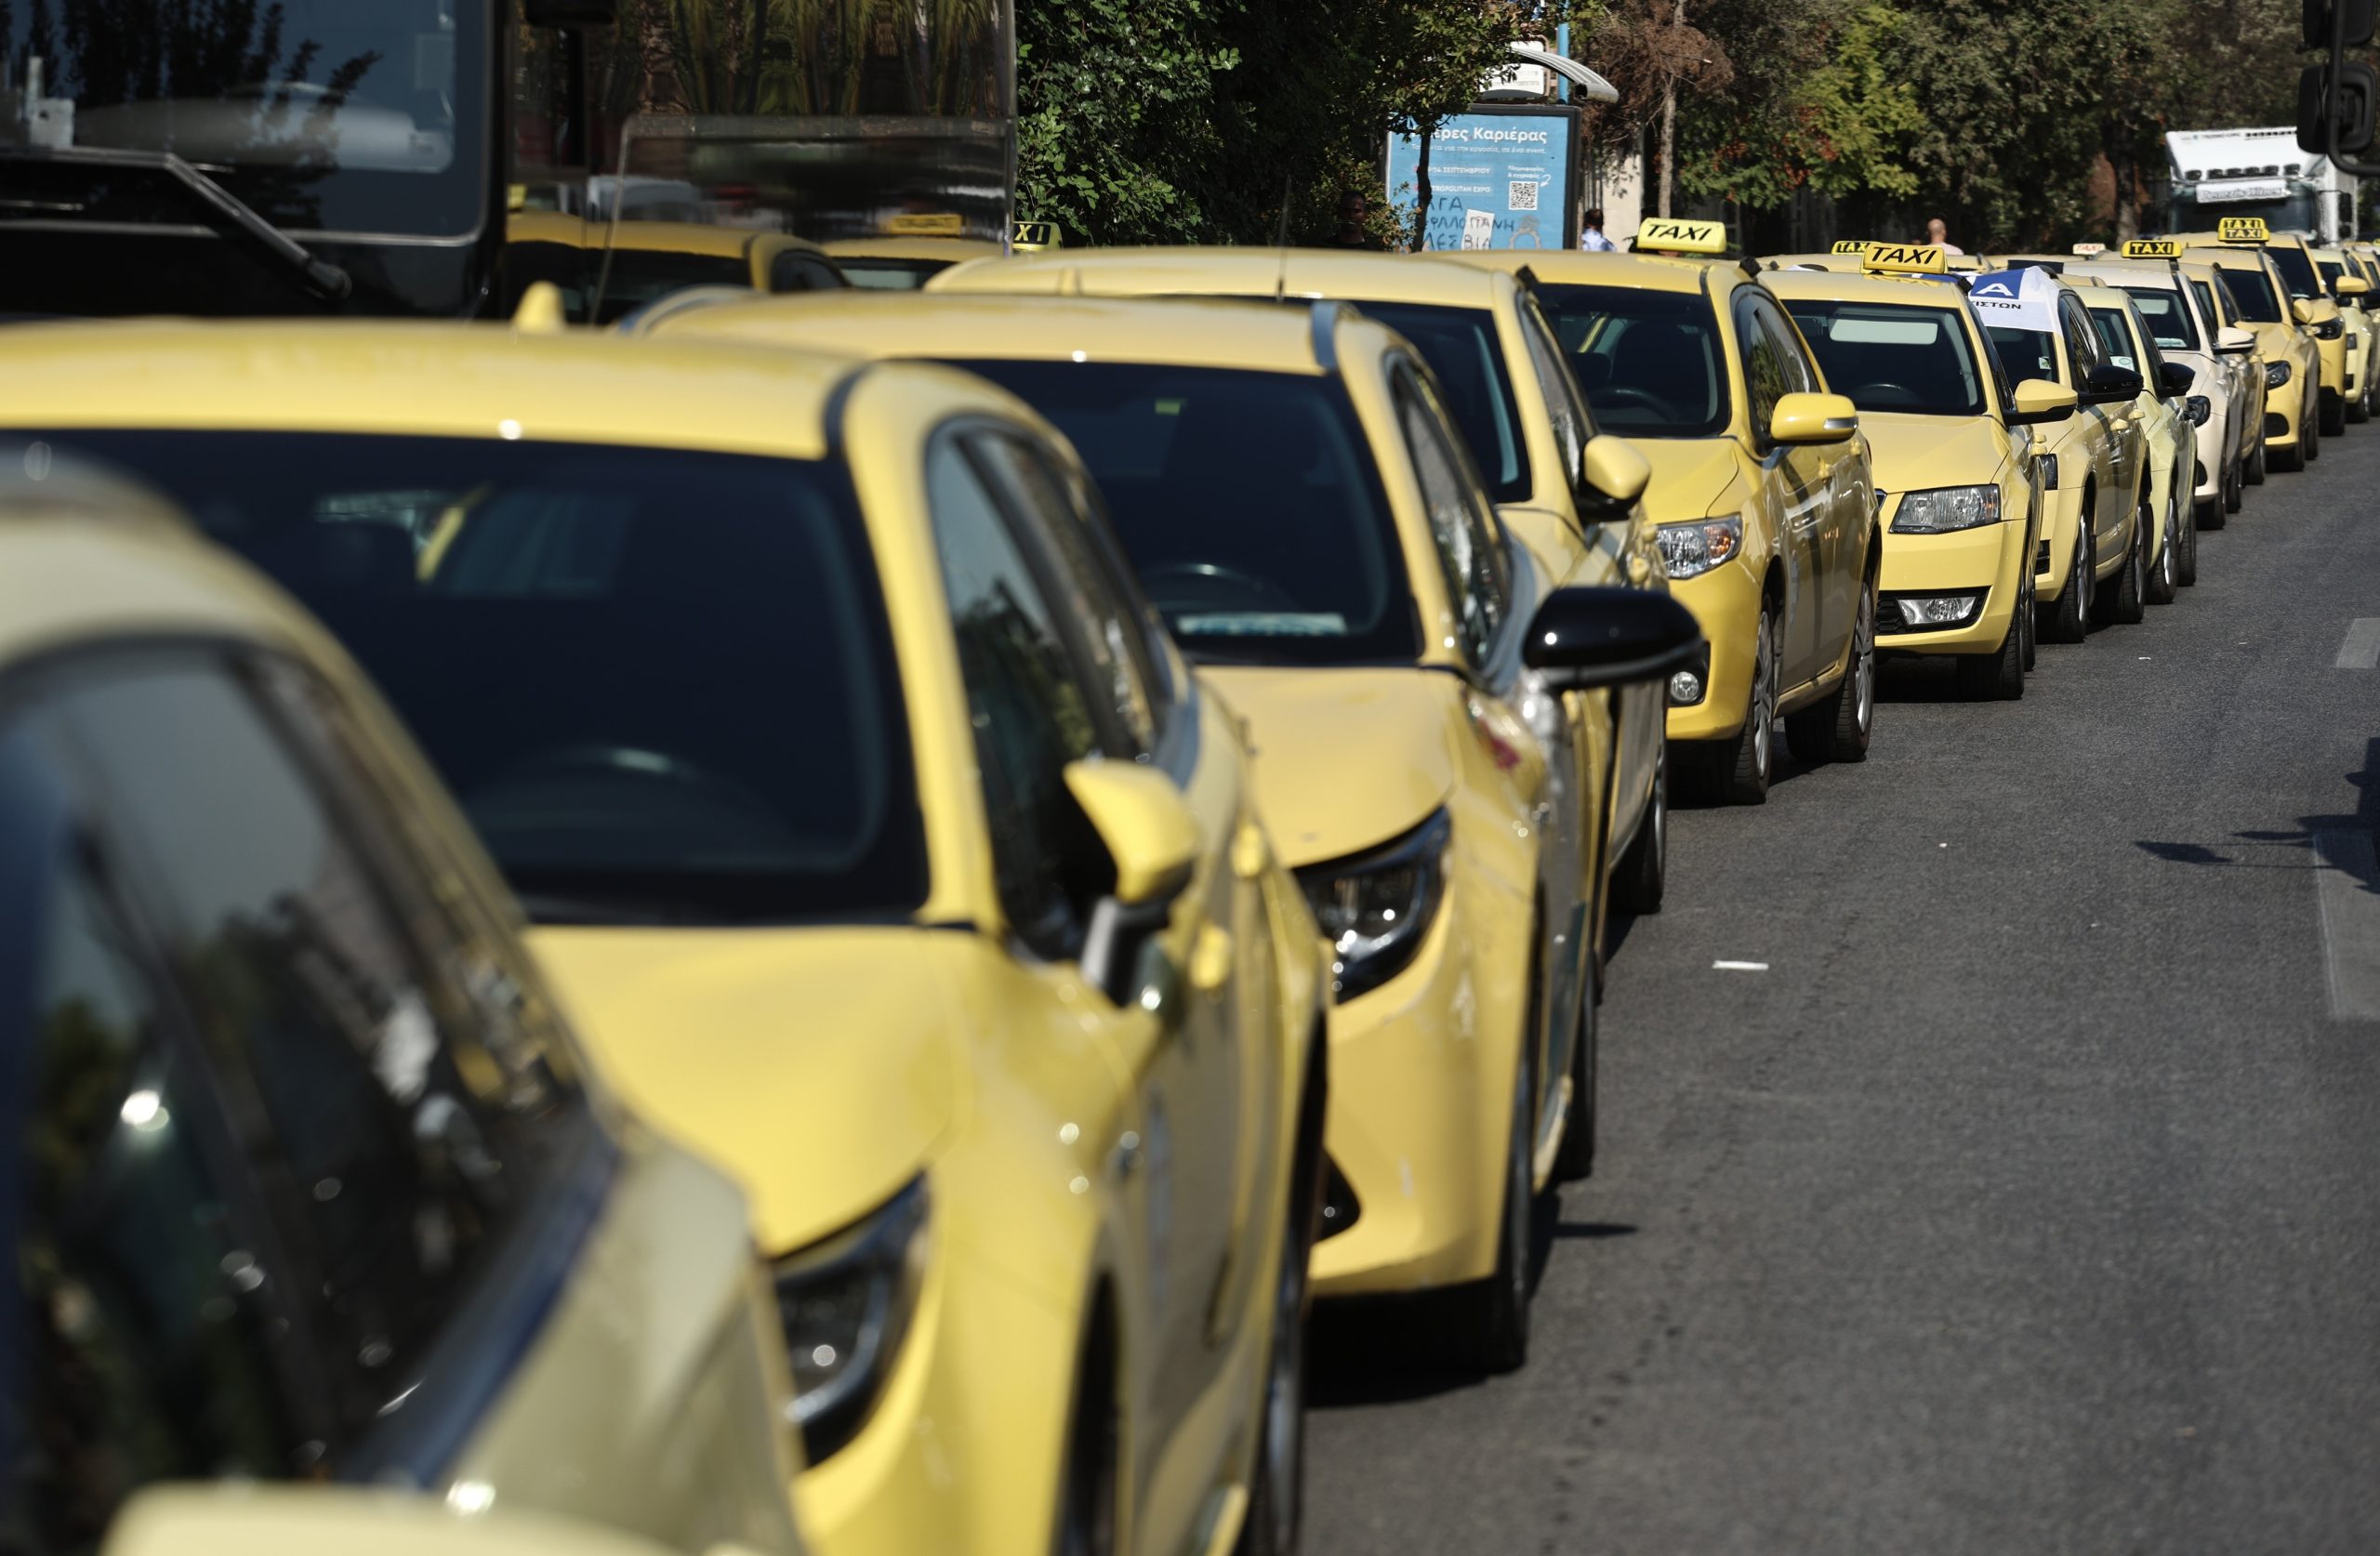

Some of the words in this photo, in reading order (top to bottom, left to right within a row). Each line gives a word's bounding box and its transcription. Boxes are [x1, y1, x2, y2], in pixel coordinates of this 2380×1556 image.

[1473, 126, 1547, 144] Καριέρας
[1430, 185, 1472, 193] TROPOLITAN
[2227, 220, 2259, 229] TAXI
[1014, 224, 1044, 242] XI
[1647, 223, 1712, 242] TAXI
[2226, 230, 2262, 238] TAXI
[1840, 243, 1869, 253] TAX
[2131, 243, 2173, 254] TAXI
[1872, 246, 1937, 265] TAXI
[1971, 301, 2021, 310] ΙΣΤΩΝ
